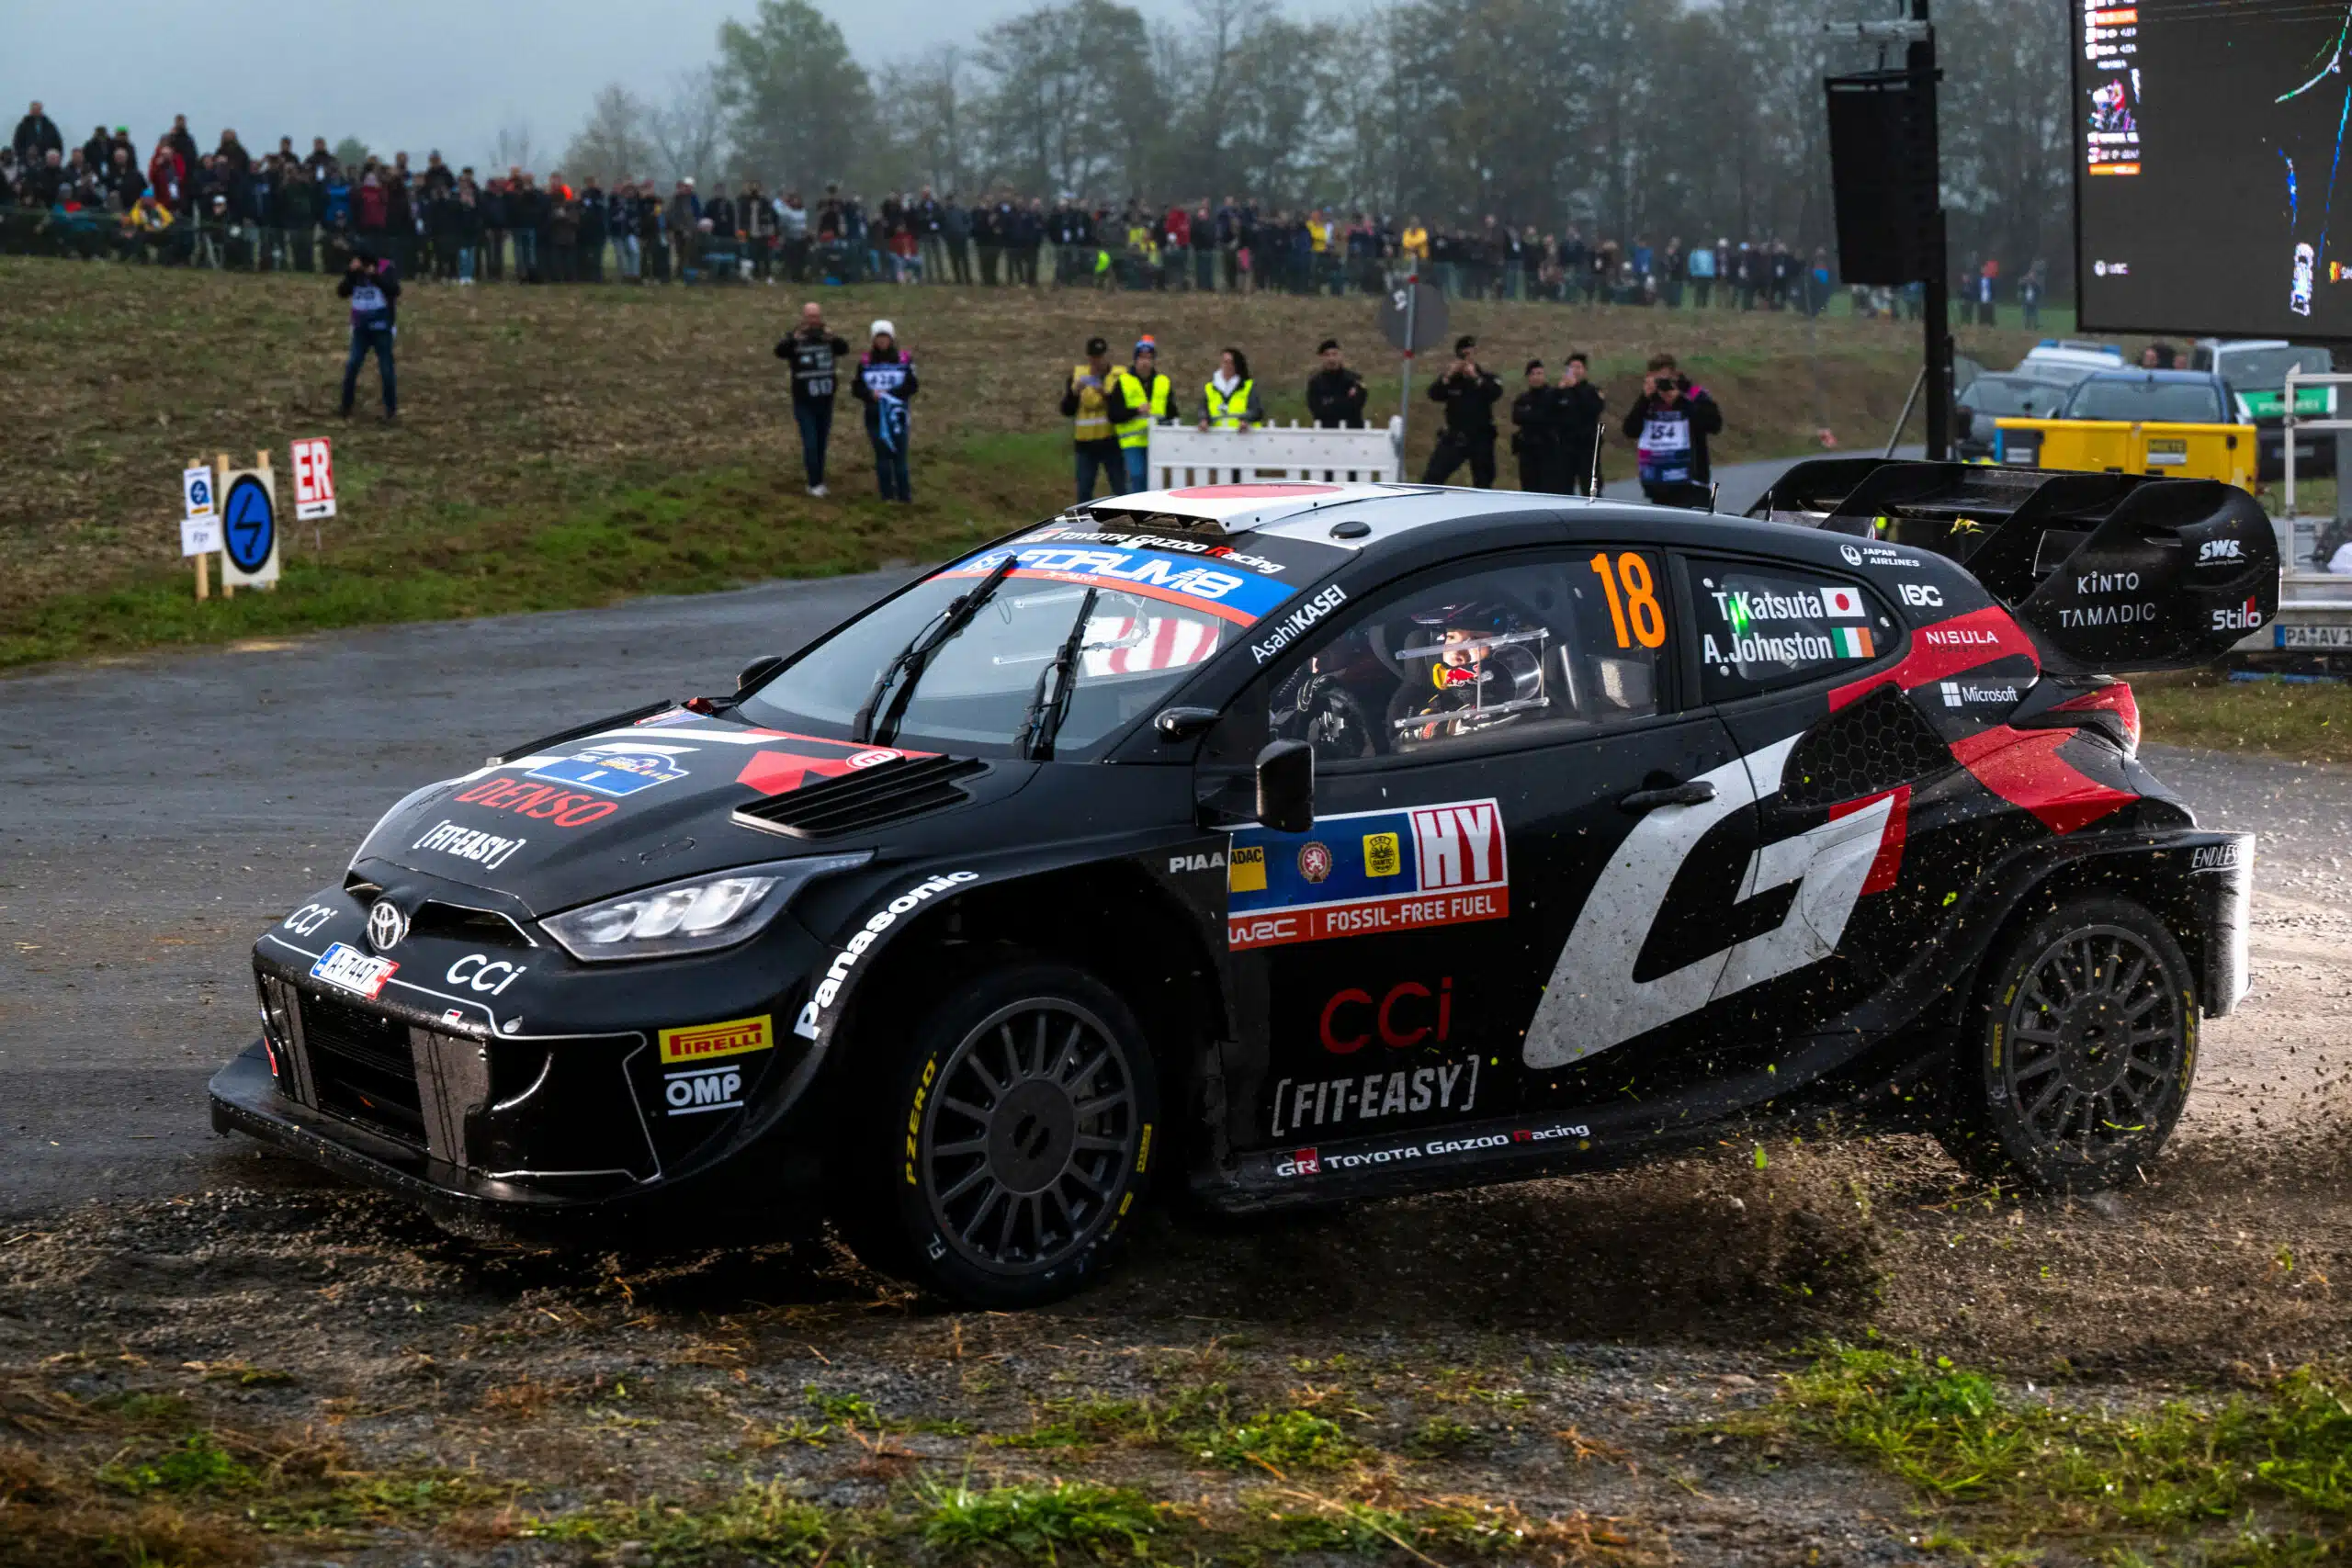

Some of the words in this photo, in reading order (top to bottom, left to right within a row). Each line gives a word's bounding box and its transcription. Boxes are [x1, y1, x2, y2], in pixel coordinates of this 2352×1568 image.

[294, 441, 332, 501] ER
[1053, 531, 1131, 544] TOYOTA
[1206, 545, 1286, 575] Racing
[1862, 547, 1897, 557] JAPAN
[1870, 557, 1920, 567] AIRLINES
[2199, 539, 2240, 560] SWS
[1015, 549, 1244, 599] FORUM8
[1589, 551, 1667, 649] 18
[2211, 597, 2262, 630] Stilo
[1250, 584, 1349, 664] AsahiKASEI
[1926, 631, 1999, 644] NISULA
[1704, 632, 1835, 664] A.Johnston
[1962, 686, 2018, 703] Microsoft
[454, 778, 618, 827] DENSO
[1169, 852, 1226, 874] PIAA
[1415, 805, 1494, 887] HY
[1228, 918, 1297, 943] WRC
[1326, 899, 1446, 932] FOSSIL-FREE
[1451, 895, 1497, 918] FUEL
[794, 871, 979, 1041] Panasonic
[669, 1023, 763, 1056] PIRELLI
[666, 1073, 741, 1107] OMP
[1324, 1146, 1422, 1169] TOYOTA
[1426, 1134, 1510, 1156] GAZOO
[1512, 1122, 1591, 1145] Racing
